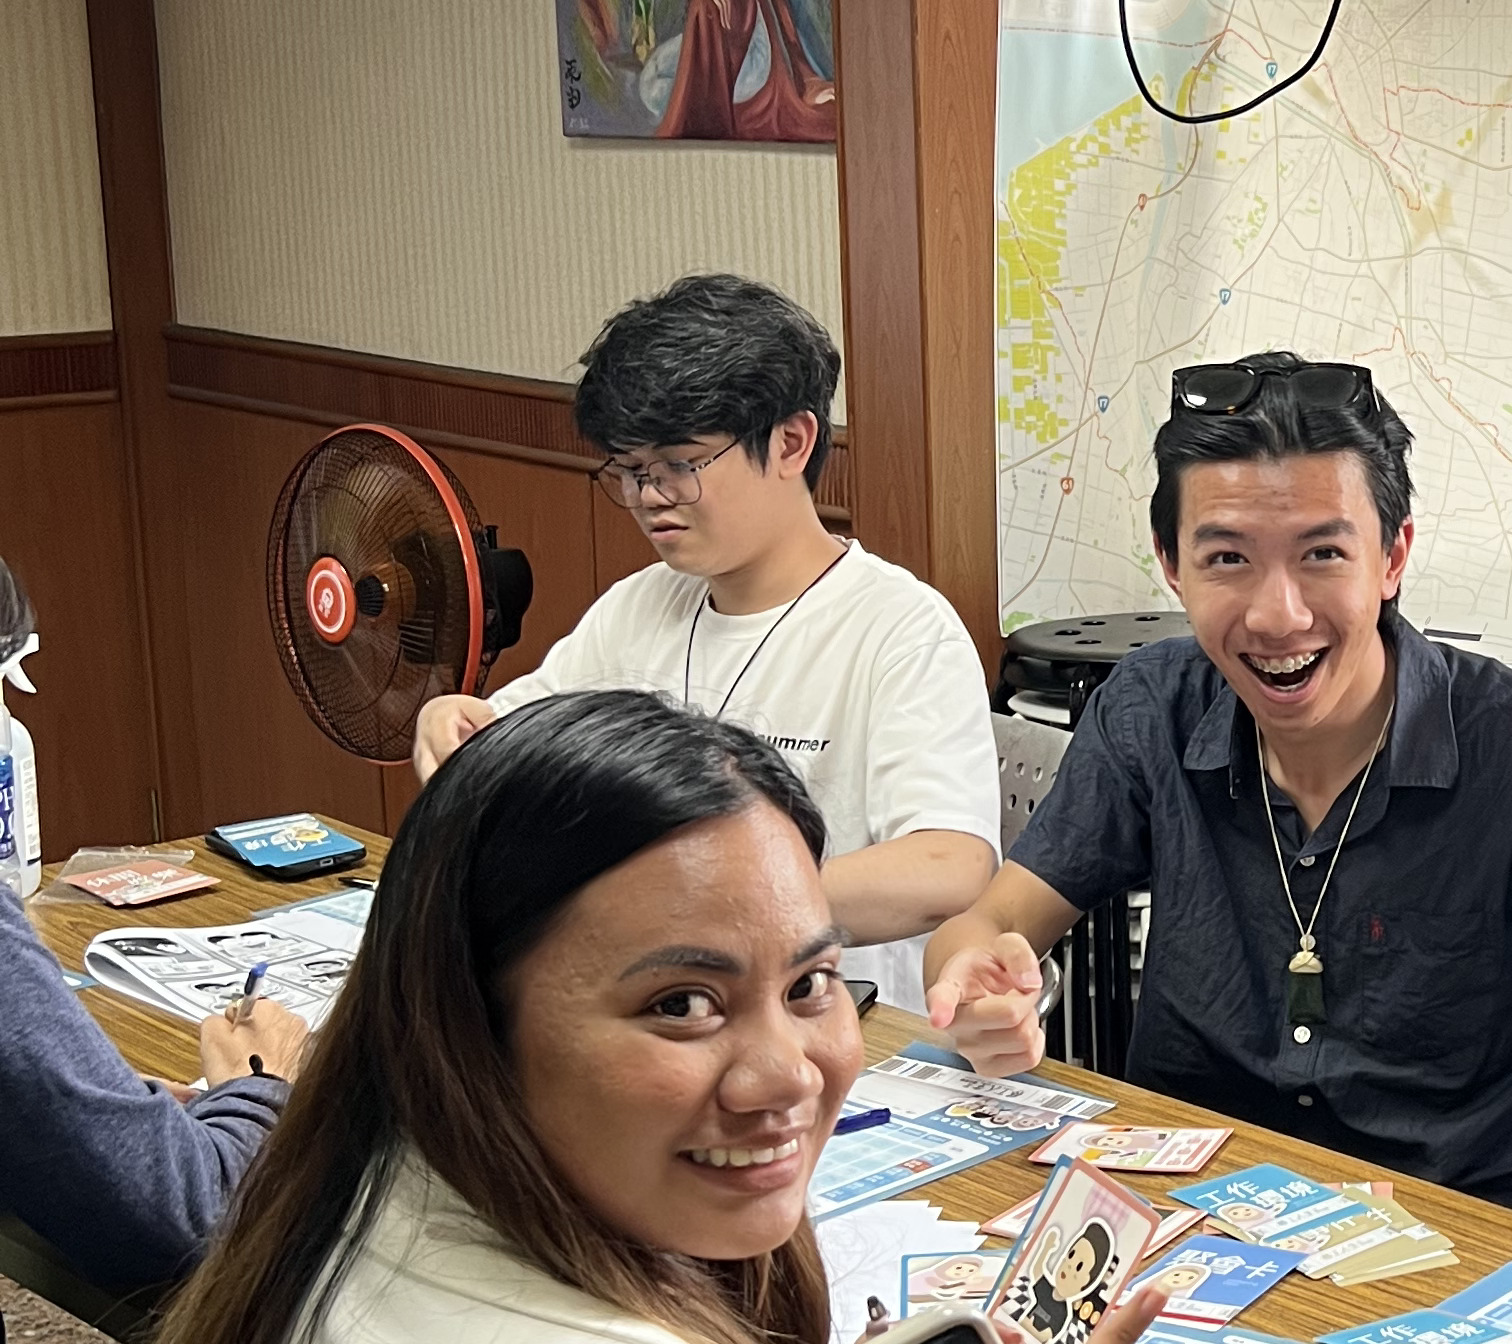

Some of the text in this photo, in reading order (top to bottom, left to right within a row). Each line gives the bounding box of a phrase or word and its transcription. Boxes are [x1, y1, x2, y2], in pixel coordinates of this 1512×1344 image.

[1062, 479, 1073, 490] 61
[759, 734, 830, 752] ummer
[1196, 1181, 1260, 1209] 工作
